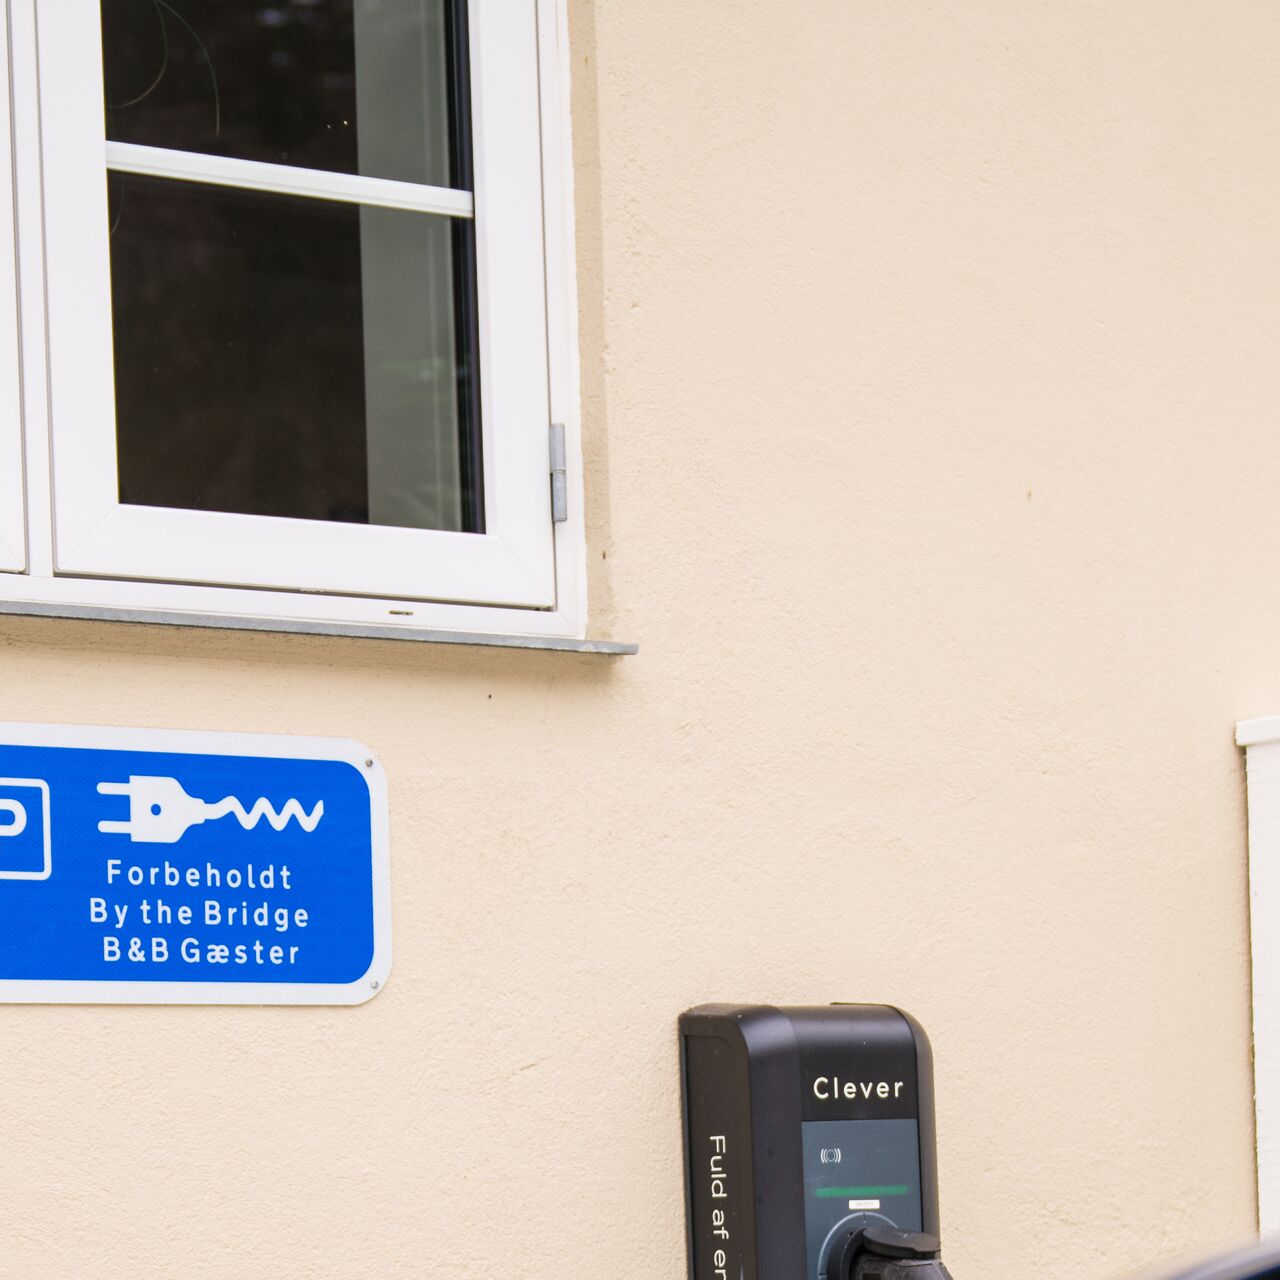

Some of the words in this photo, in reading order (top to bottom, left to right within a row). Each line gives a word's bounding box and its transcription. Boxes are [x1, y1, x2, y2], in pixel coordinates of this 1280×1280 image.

[108, 860, 290, 889] Forbeholdt
[91, 898, 127, 928] By
[140, 900, 192, 924] the
[205, 901, 308, 931] Bridge
[104, 937, 168, 961] B&B
[181, 938, 298, 964] Gæster
[813, 1076, 904, 1099] Clever
[709, 1135, 728, 1198] Fuld
[712, 1208, 729, 1240] af
